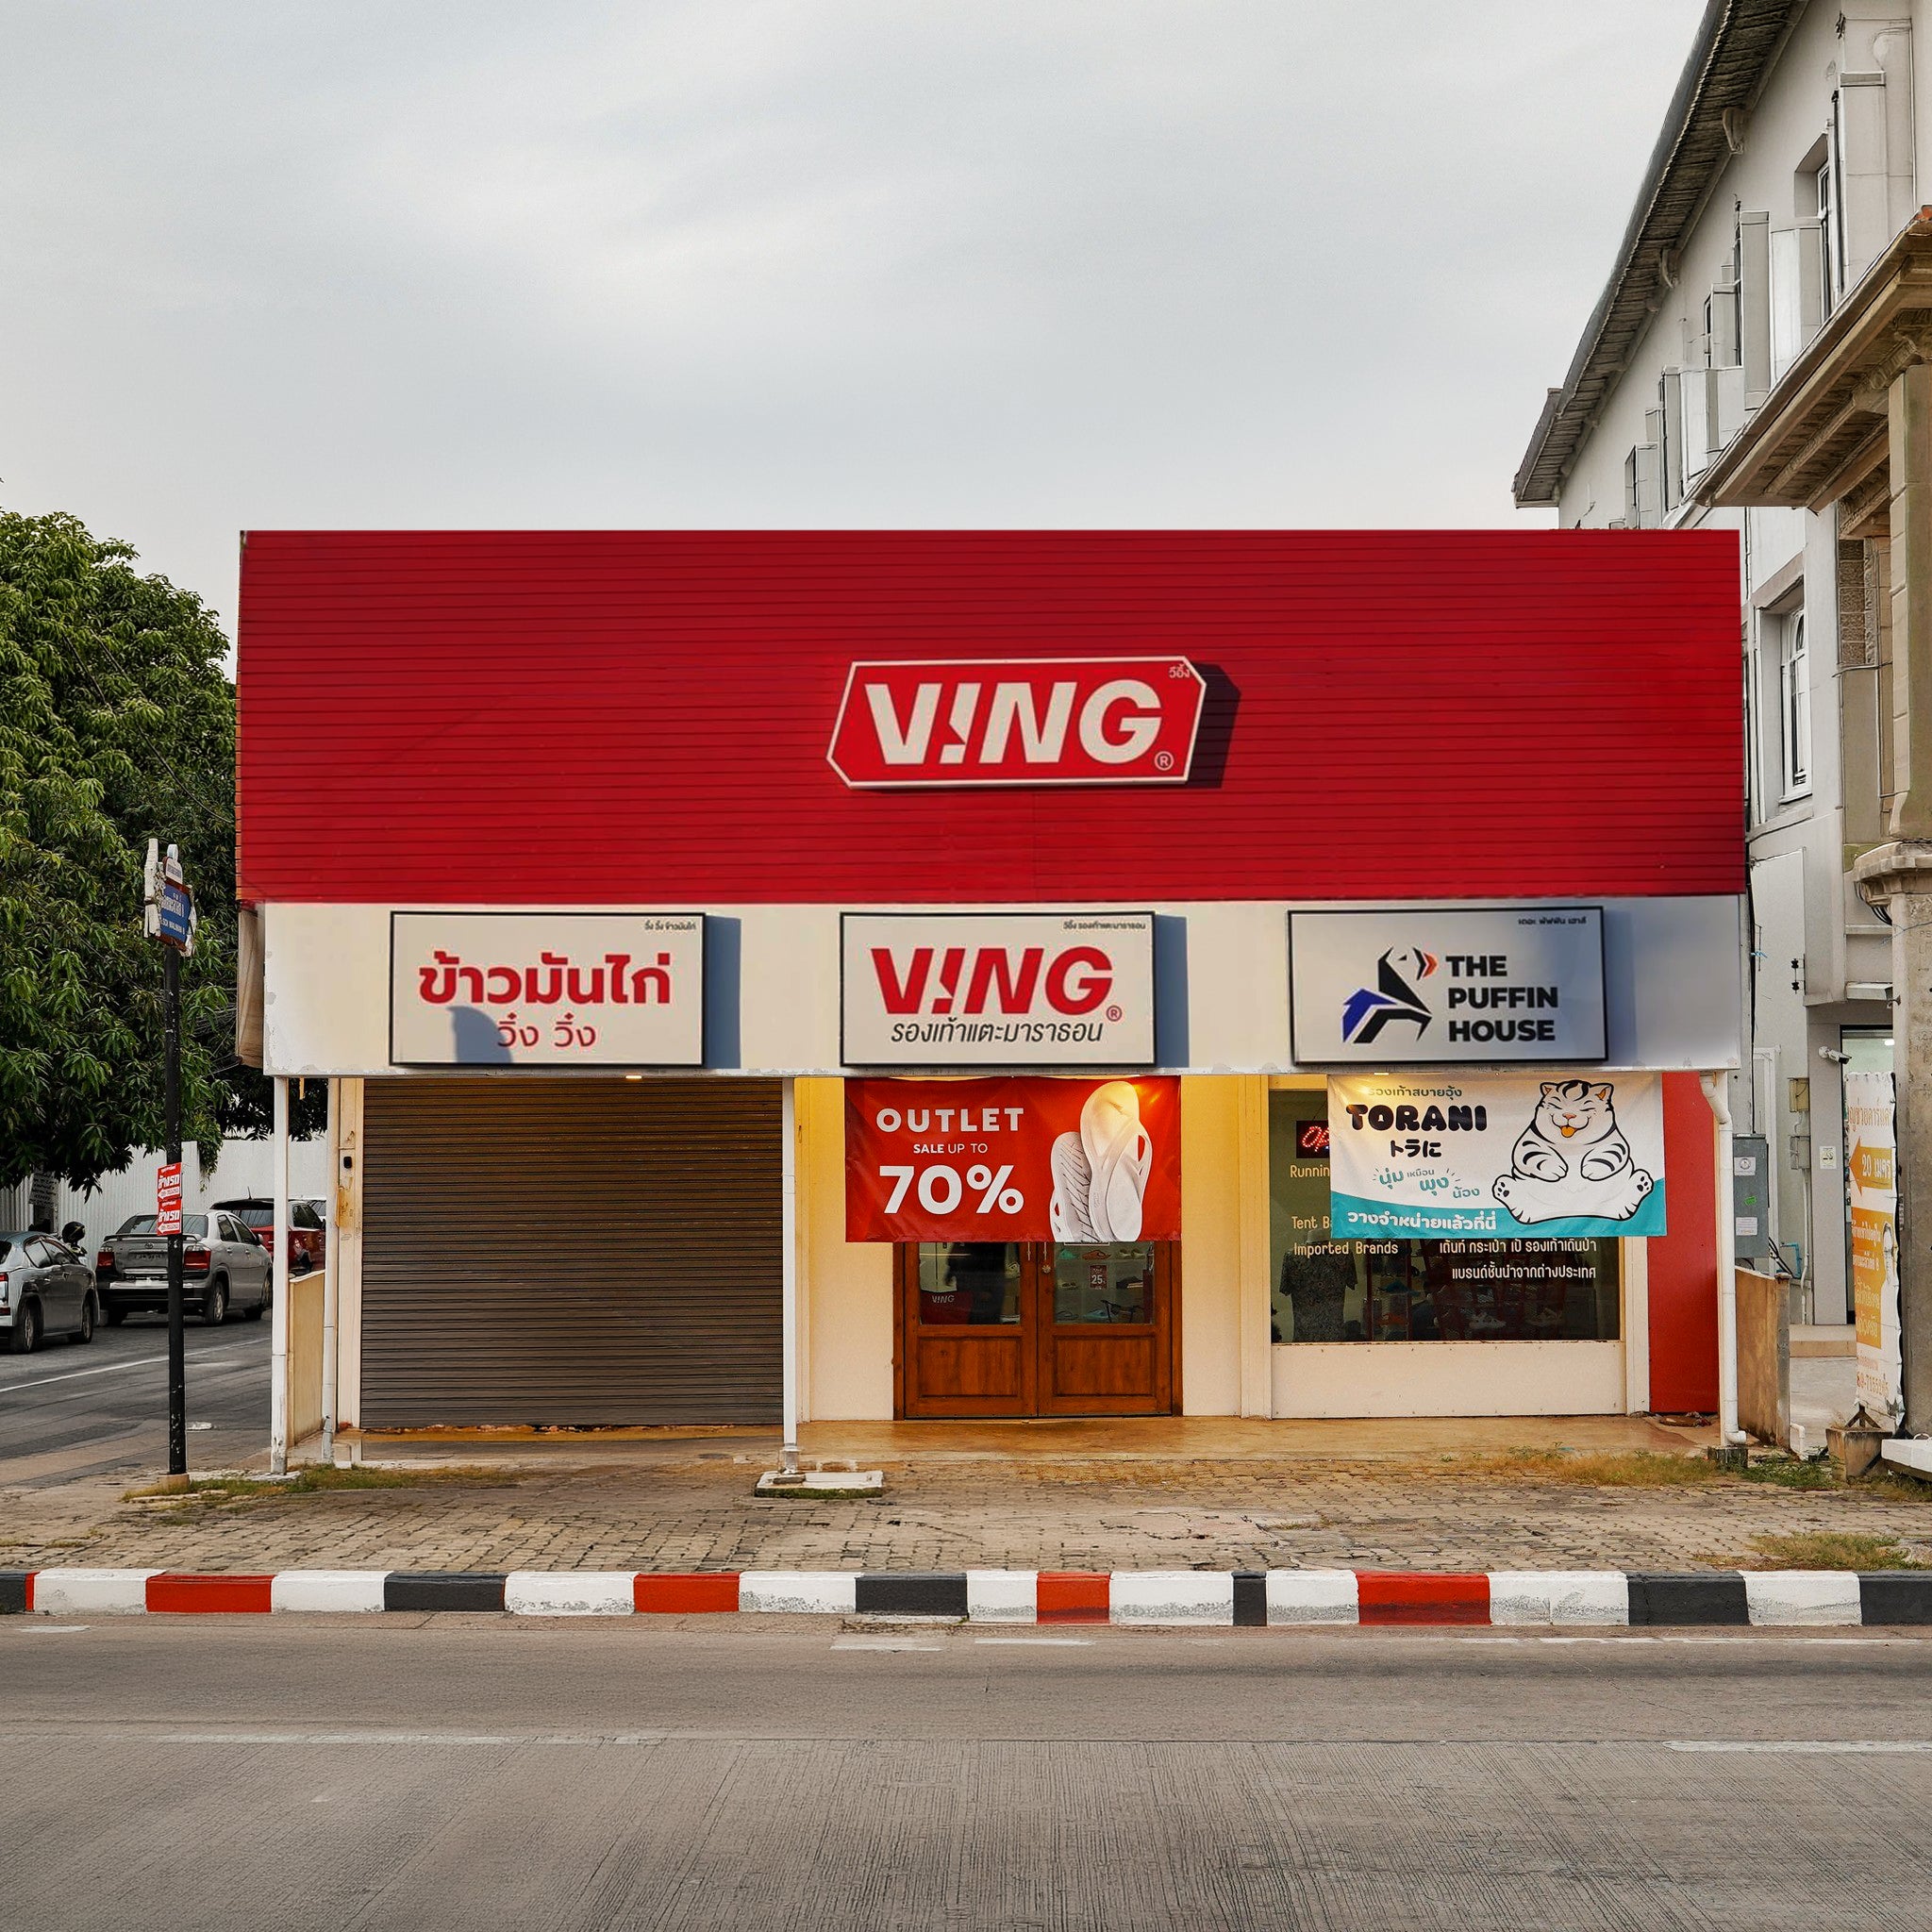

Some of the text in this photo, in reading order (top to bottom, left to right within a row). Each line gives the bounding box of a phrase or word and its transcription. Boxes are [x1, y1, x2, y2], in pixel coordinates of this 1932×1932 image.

[1445, 955, 1507, 977] THE
[419, 950, 671, 1004] ข้าวมันไก่
[1448, 987, 1558, 1009] PUFFIN
[891, 1017, 1104, 1043] รองเท้าแตะมาราธอน
[1449, 1019, 1556, 1042] HOUSE
[876, 1108, 1024, 1132] OUTLET
[1345, 1104, 1488, 1131] TORANI
[913, 1143, 988, 1155] SALE UP TO
[1391, 1139, 1441, 1158] トラに
[1290, 1164, 1330, 1178] Runnin
[1861, 1154, 1872, 1177] 20
[879, 1164, 1024, 1215] 70%
[1379, 1168, 1435, 1190] นุ่ม เหมือน
[1420, 1176, 1449, 1196] พุง
[1453, 1187, 1480, 1199] น้อง
[1291, 1216, 1318, 1229] Tent
[1347, 1210, 1497, 1230] วางจำหน่ายแล้วที่นี่
[1294, 1241, 1399, 1257] Imported Brands
[1525, 1238, 1597, 1252] รองเท้าเดินป่า
[1453, 1261, 1596, 1279] แบรนด์ชั้นนำจากต่างประเทศ
